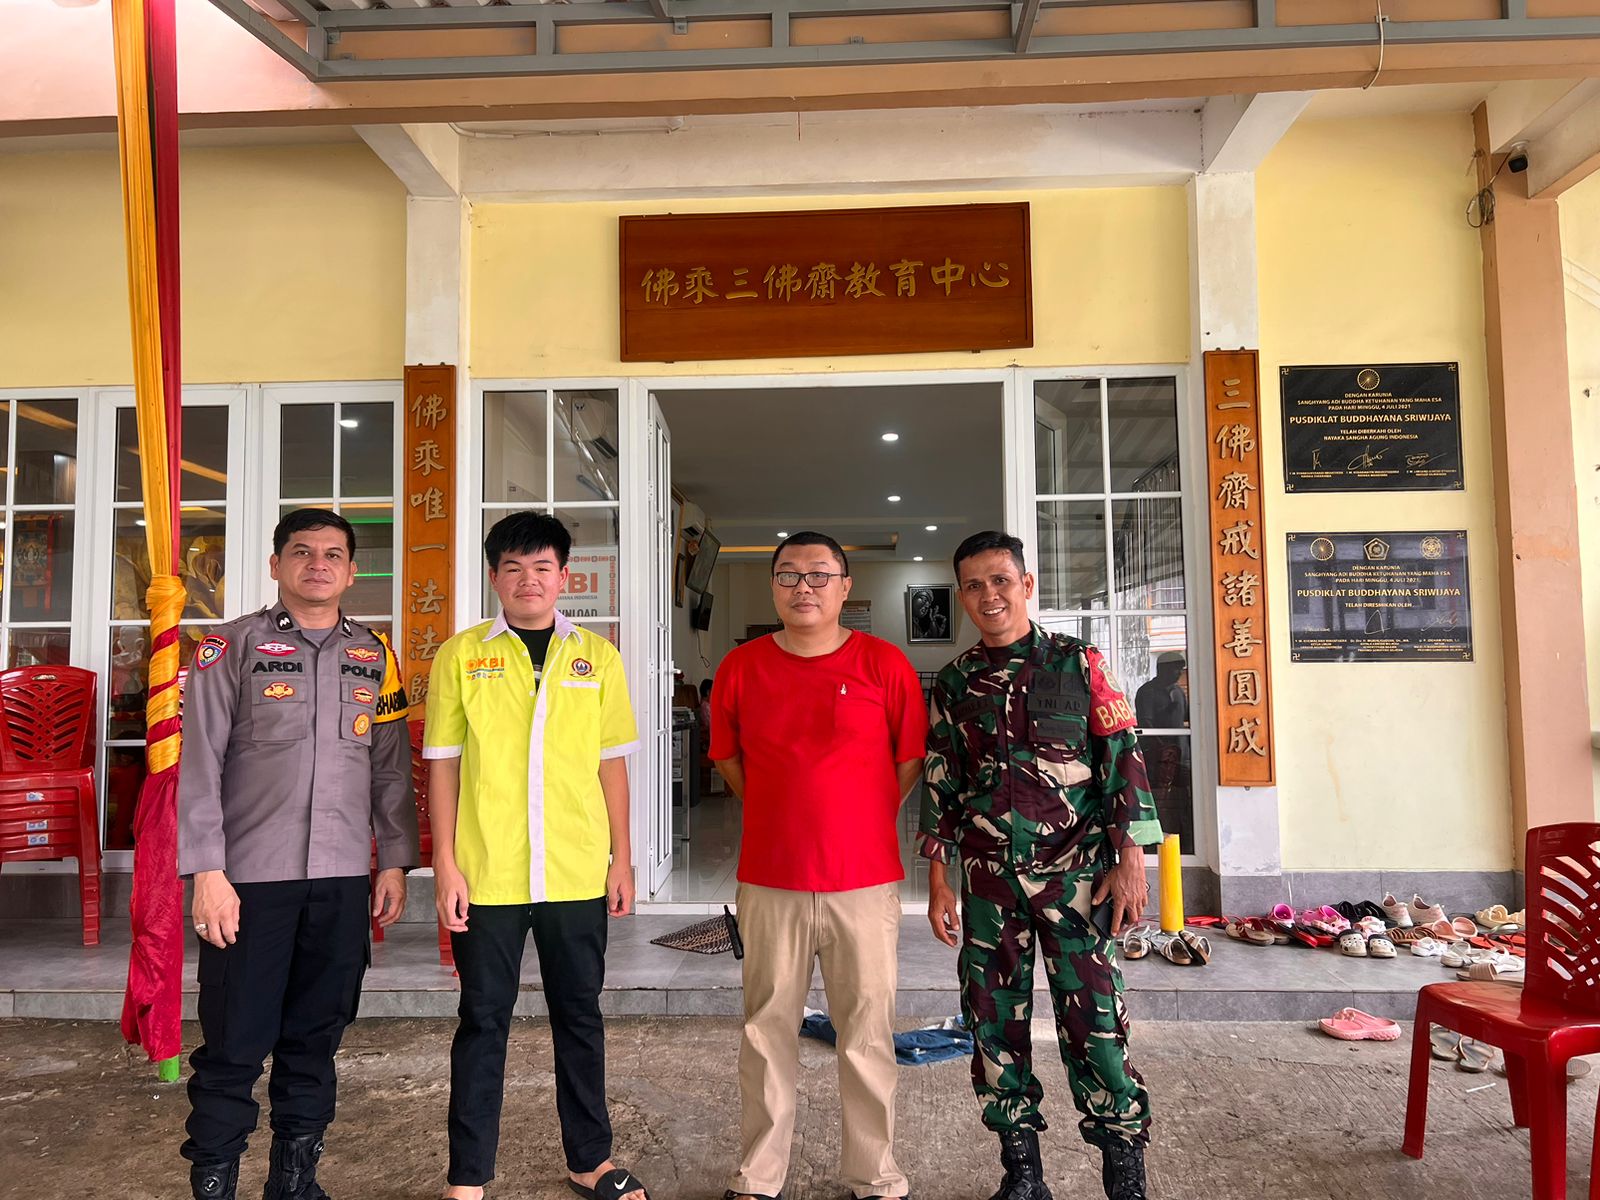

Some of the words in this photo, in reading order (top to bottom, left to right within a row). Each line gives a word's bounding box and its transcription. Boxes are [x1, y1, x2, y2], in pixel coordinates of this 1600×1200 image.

[1289, 415, 1339, 425] PUSDIKLAT
[1340, 414, 1403, 424] BUDDHAYANA
[1404, 412, 1452, 423] SRIWIJAYA
[1296, 588, 1346, 598] PUSDIKLAT
[1348, 588, 1412, 597] BUDDHAYANA
[1413, 587, 1461, 597] SRIWIJAYA
[252, 661, 303, 674] ARDI
[477, 657, 505, 669] KBI
[376, 687, 408, 716] BHAB
[1095, 696, 1133, 729] BABI
